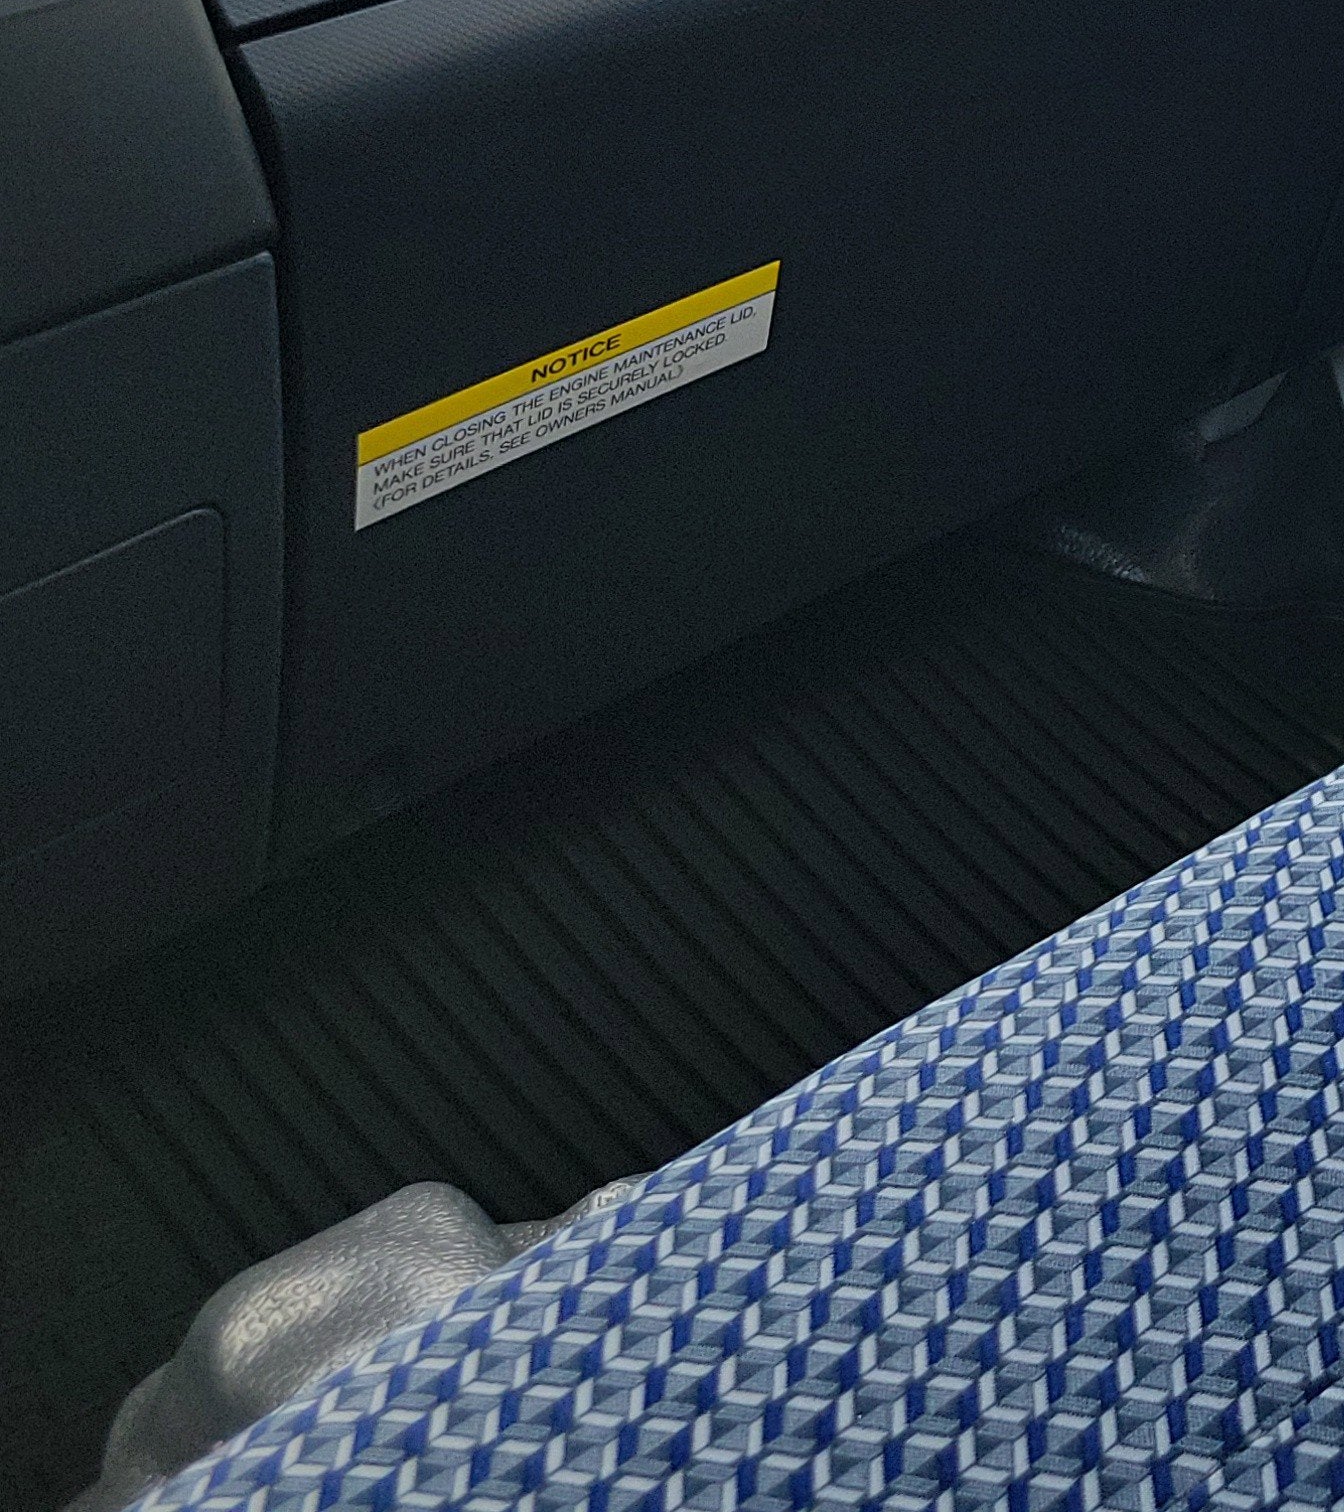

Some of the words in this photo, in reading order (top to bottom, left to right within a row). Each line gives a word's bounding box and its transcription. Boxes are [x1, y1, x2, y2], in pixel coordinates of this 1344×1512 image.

[374, 445, 426, 476] WHEN
[432, 411, 506, 451] CLOSING
[513, 394, 544, 416] THE
[550, 366, 610, 400] ENGINE
[613, 316, 726, 373] MAINTENANCE
[531, 334, 622, 383] NOTICE
[373, 462, 425, 495] MAKE
[430, 440, 475, 469] SURE
[481, 419, 523, 445] THAT
[528, 406, 552, 426] LID
[558, 398, 572, 414] IS
[577, 362, 659, 405] SECURELY
[500, 431, 531, 454] SEE
[536, 399, 605, 437] OWNERS
